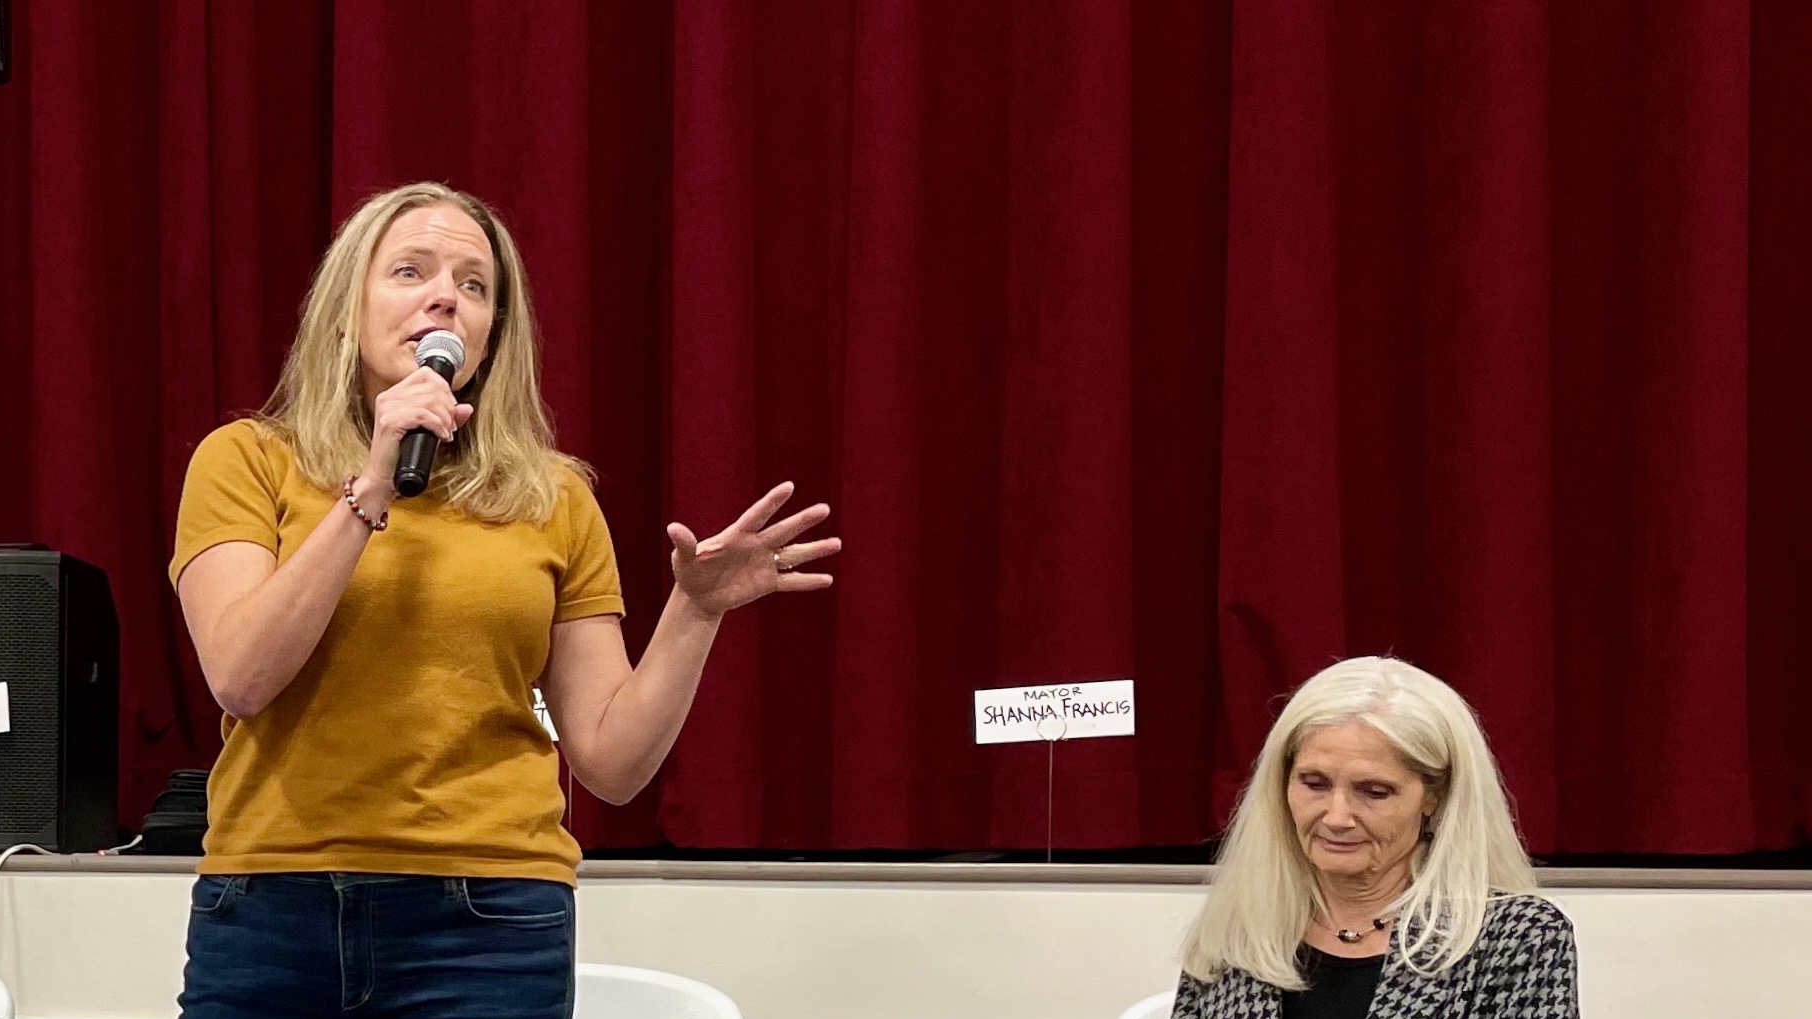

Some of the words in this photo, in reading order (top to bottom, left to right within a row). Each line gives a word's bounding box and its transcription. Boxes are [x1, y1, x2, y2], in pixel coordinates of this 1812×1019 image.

[1023, 686, 1083, 701] MAYOR
[983, 704, 1057, 726] SHANNA
[1062, 697, 1131, 719] FRANCIS
